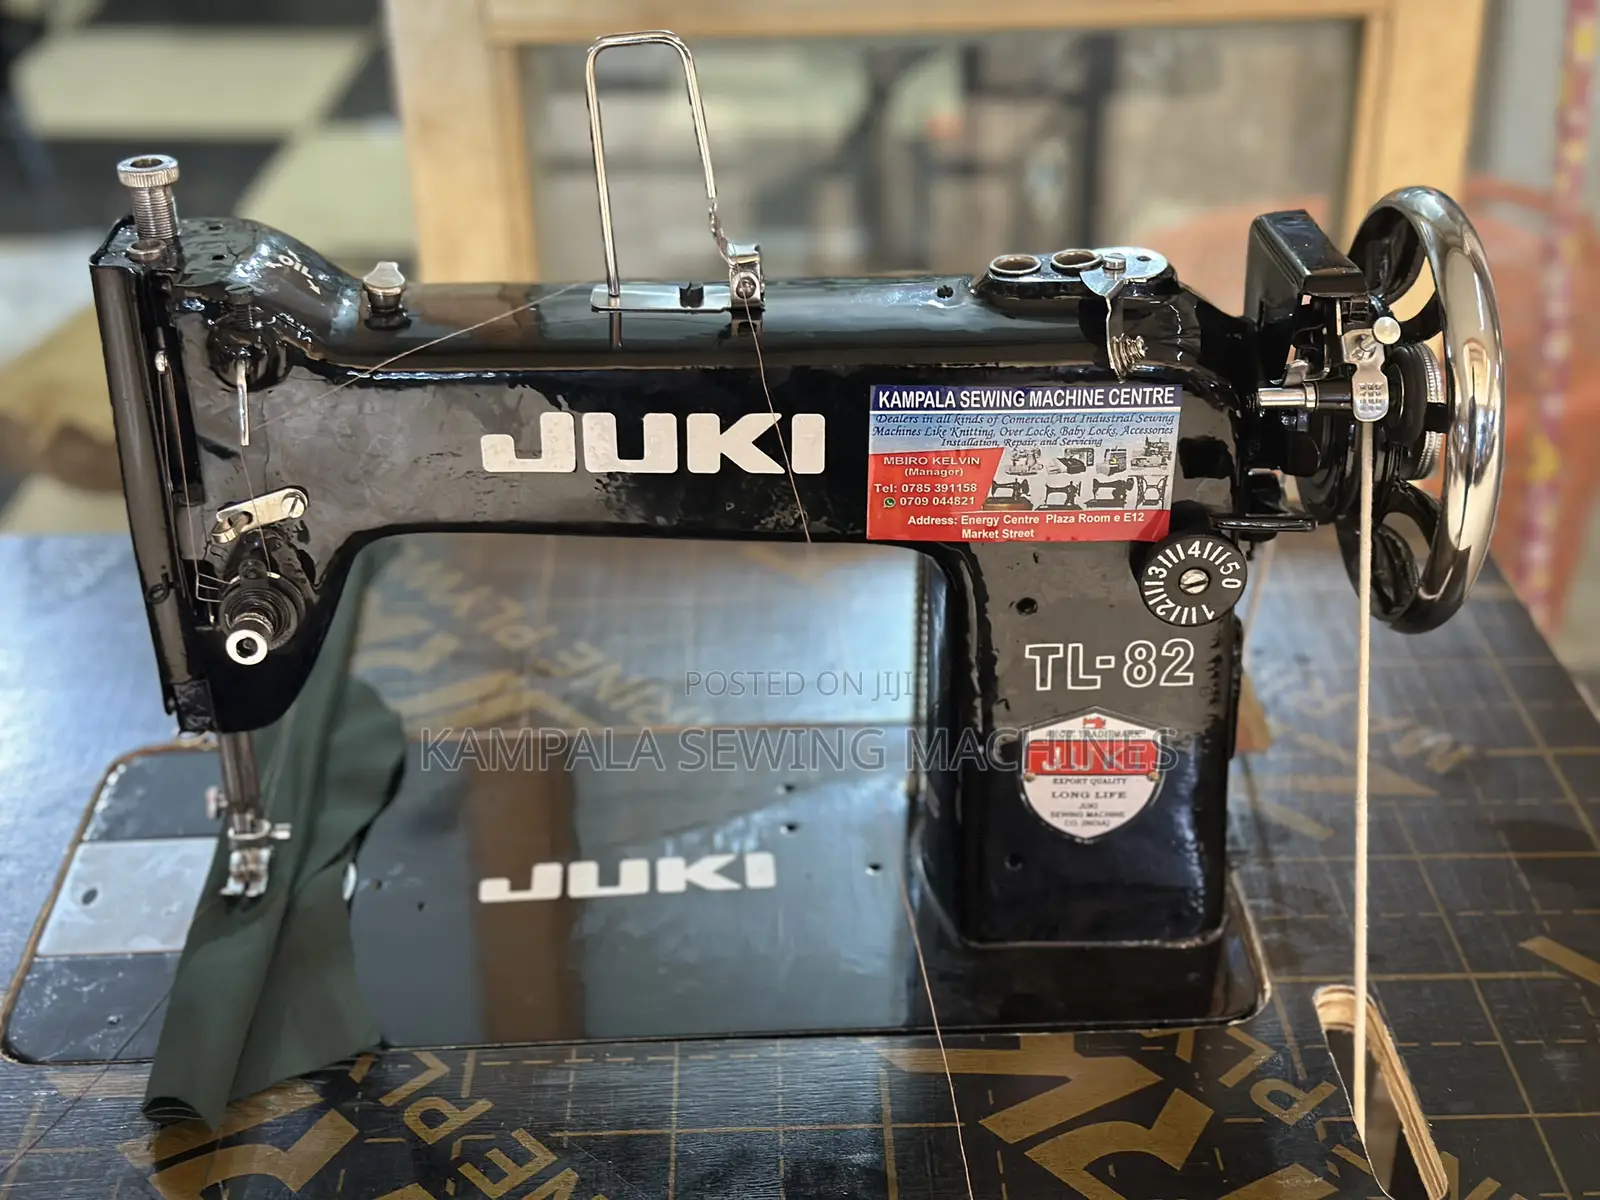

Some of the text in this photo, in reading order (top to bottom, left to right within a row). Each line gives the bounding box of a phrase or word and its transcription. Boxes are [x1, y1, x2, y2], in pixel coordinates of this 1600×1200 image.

[278, 254, 314, 279] OIL
[878, 386, 1175, 408] KAMPALA SEWING MACHINE CENTRE
[876, 413, 919, 425] Dealers
[922, 413, 934, 425] in
[936, 413, 952, 425] all
[953, 413, 985, 426] kinds
[987, 413, 1001, 426] of
[1079, 413, 1133, 424] Industrial
[1135, 412, 1175, 427] Sewing
[872, 423, 1174, 440] Machines Like Knitting, Over Locks, Baby Locks, Accessories
[480, 411, 825, 475] JUKI
[940, 437, 1104, 448] Installation, Repair, and Servicing
[931, 456, 981, 465] KELVIN
[874, 483, 978, 494] Tel: 0785 391158
[899, 495, 976, 506] 0709 044821
[908, 515, 958, 526] Address:
[960, 515, 1000, 528] Energy
[1002, 514, 1040, 525] Centre
[1045, 513, 1076, 524] Plaza
[1077, 513, 1112, 524] Room
[1123, 512, 1145, 523] E12
[961, 528, 1035, 539] Market Street
[1025, 638, 1194, 691] TL-82
[1052, 777, 1128, 787] EXPORT QUALITY
[1051, 791, 1128, 799] LONG LIFE
[479, 852, 777, 903] JUKI
